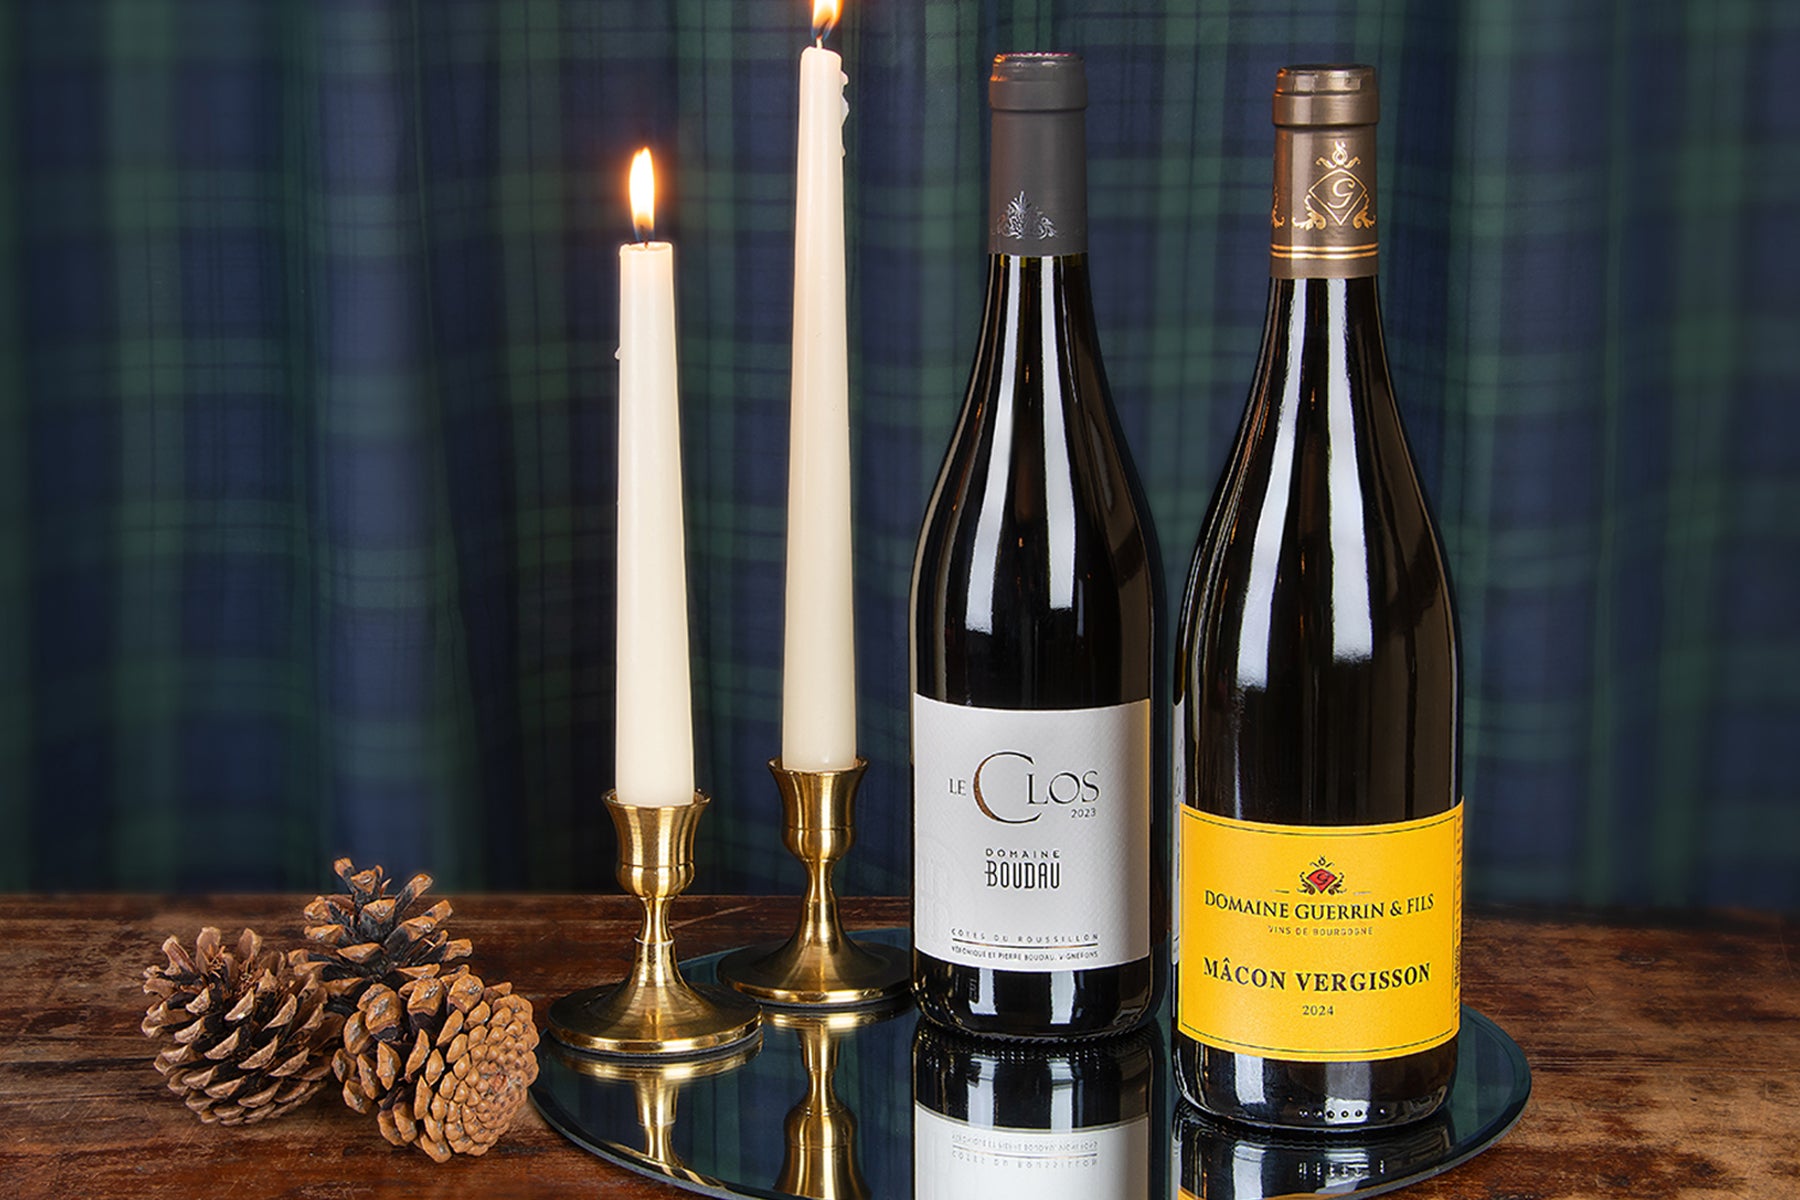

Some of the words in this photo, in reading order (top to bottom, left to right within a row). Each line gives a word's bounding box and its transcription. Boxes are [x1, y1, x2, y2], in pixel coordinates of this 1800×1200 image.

[949, 778, 966, 796] LE
[972, 751, 1100, 824] CLOS
[1071, 808, 1096, 819] 2023
[985, 848, 1061, 859] DOMAINE
[984, 860, 1060, 889] BOUDAU
[1204, 890, 1289, 919] DOMAINE
[1295, 902, 1385, 920] GUERRIN
[1389, 901, 1402, 917] &
[1406, 893, 1434, 914] FILS
[1268, 925, 1291, 935] VINS
[1295, 927, 1308, 936] DE
[1313, 927, 1373, 936] BOURGOGNE
[994, 934, 1008, 942] DU
[1017, 934, 1098, 943] ROUSSILLON
[1203, 957, 1286, 990] MÂCON
[1295, 962, 1431, 992] VERGISSON
[1302, 1005, 1335, 1016] 2024
